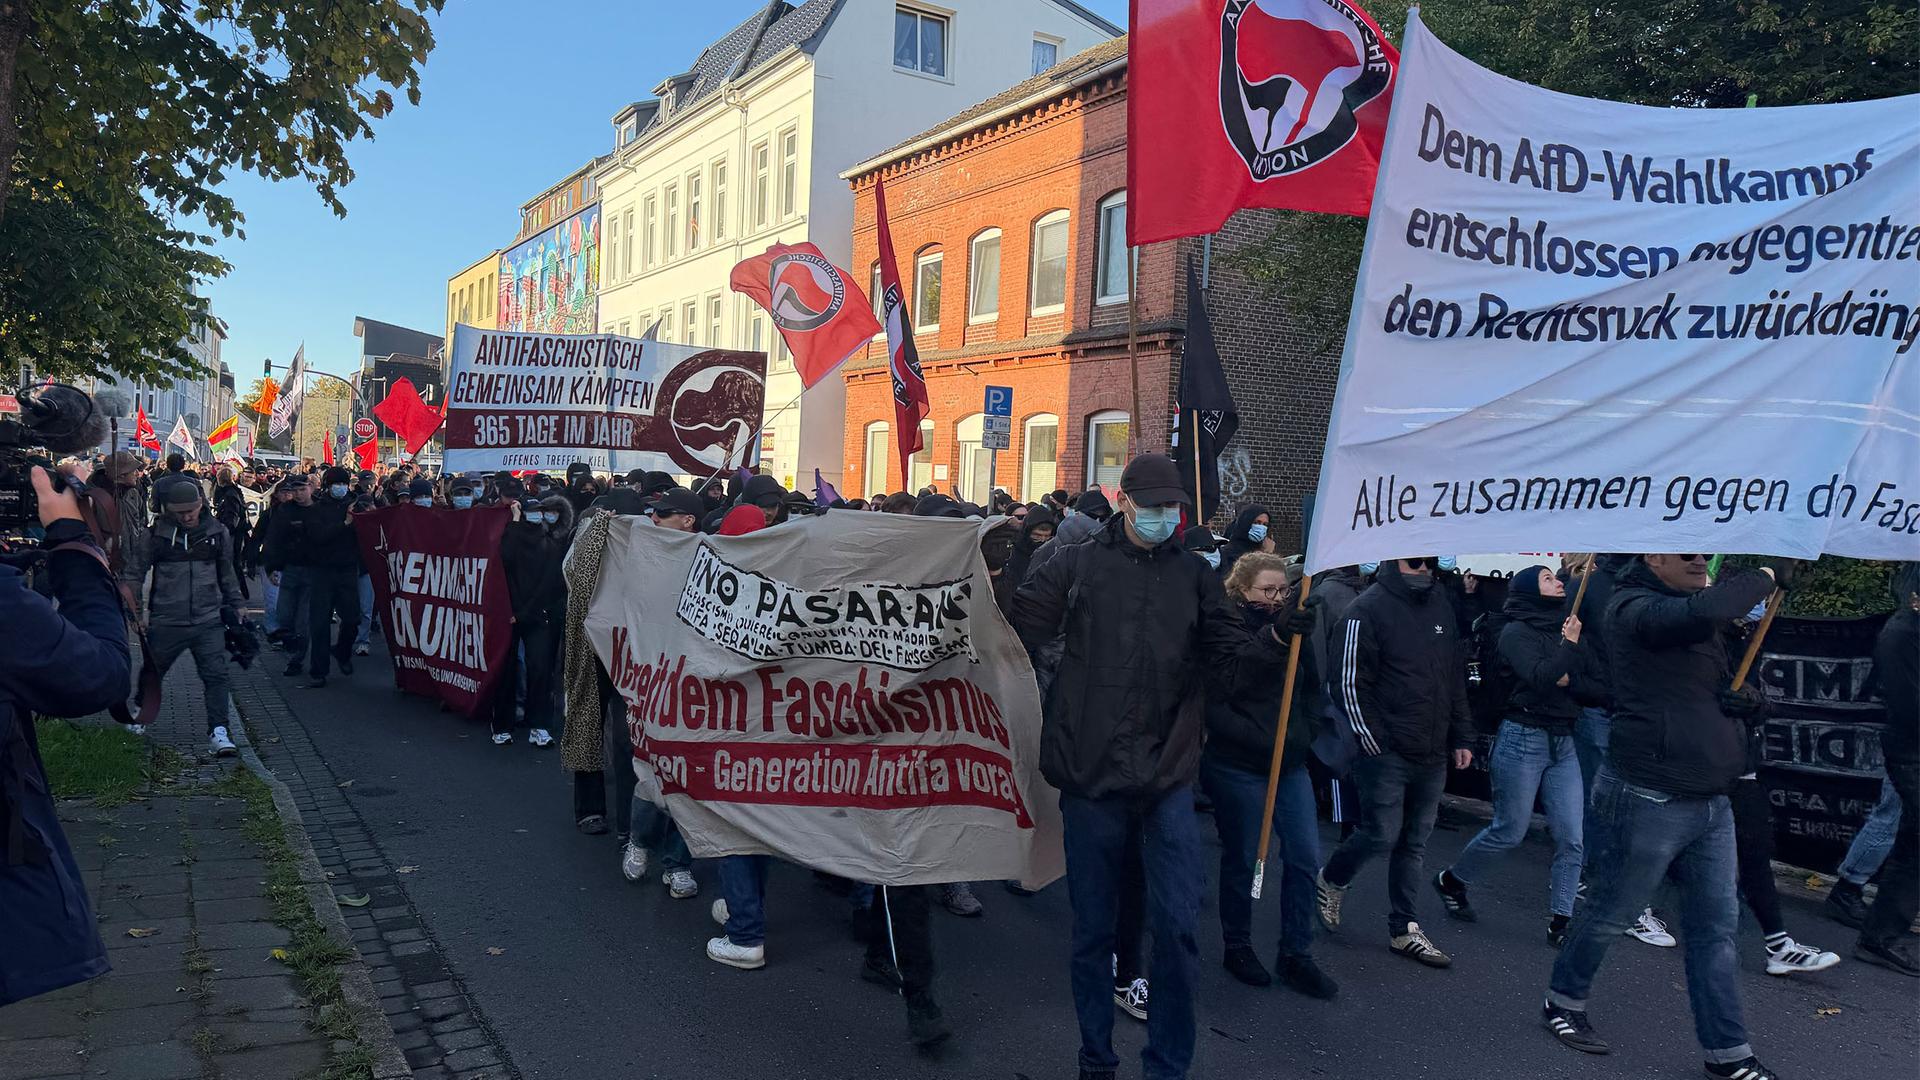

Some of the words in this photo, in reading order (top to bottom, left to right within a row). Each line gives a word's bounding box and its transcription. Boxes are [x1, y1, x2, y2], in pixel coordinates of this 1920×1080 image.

[1418, 103, 1500, 181] Dem
[1510, 138, 1874, 205] AfD-Wahlkampf
[1406, 206, 1679, 280] entschlossen
[1382, 284, 1462, 338] den
[1466, 292, 1682, 342] Rechtsruck
[1687, 289, 1920, 354] zurückdräng
[474, 334, 643, 371] ANTIFASCHISTISCH
[454, 371, 564, 405] GEMEINSAM
[569, 370, 654, 411] KÄMPFEN
[356, 423, 374, 433] STOP
[474, 415, 509, 446] 365
[515, 415, 558, 445] TAGE
[563, 415, 586, 445] IM
[590, 418, 634, 448] JAHR
[503, 453, 540, 466] OFFENES
[546, 454, 582, 467] TREFFEN
[589, 455, 606, 467] KIEL
[1351, 476, 1417, 531] Alle
[1429, 476, 1648, 519] zusammen
[1664, 475, 1790, 523] gegen
[1860, 482, 1920, 535] Fasc
[781, 640, 857, 657] TUMBA
[860, 640, 891, 661] DEL
[893, 629, 940, 647] MADRID
[659, 655, 747, 732] dem
[759, 664, 1011, 751] Faschismus
[713, 749, 863, 795] Generation
[863, 749, 951, 796] Antifa
